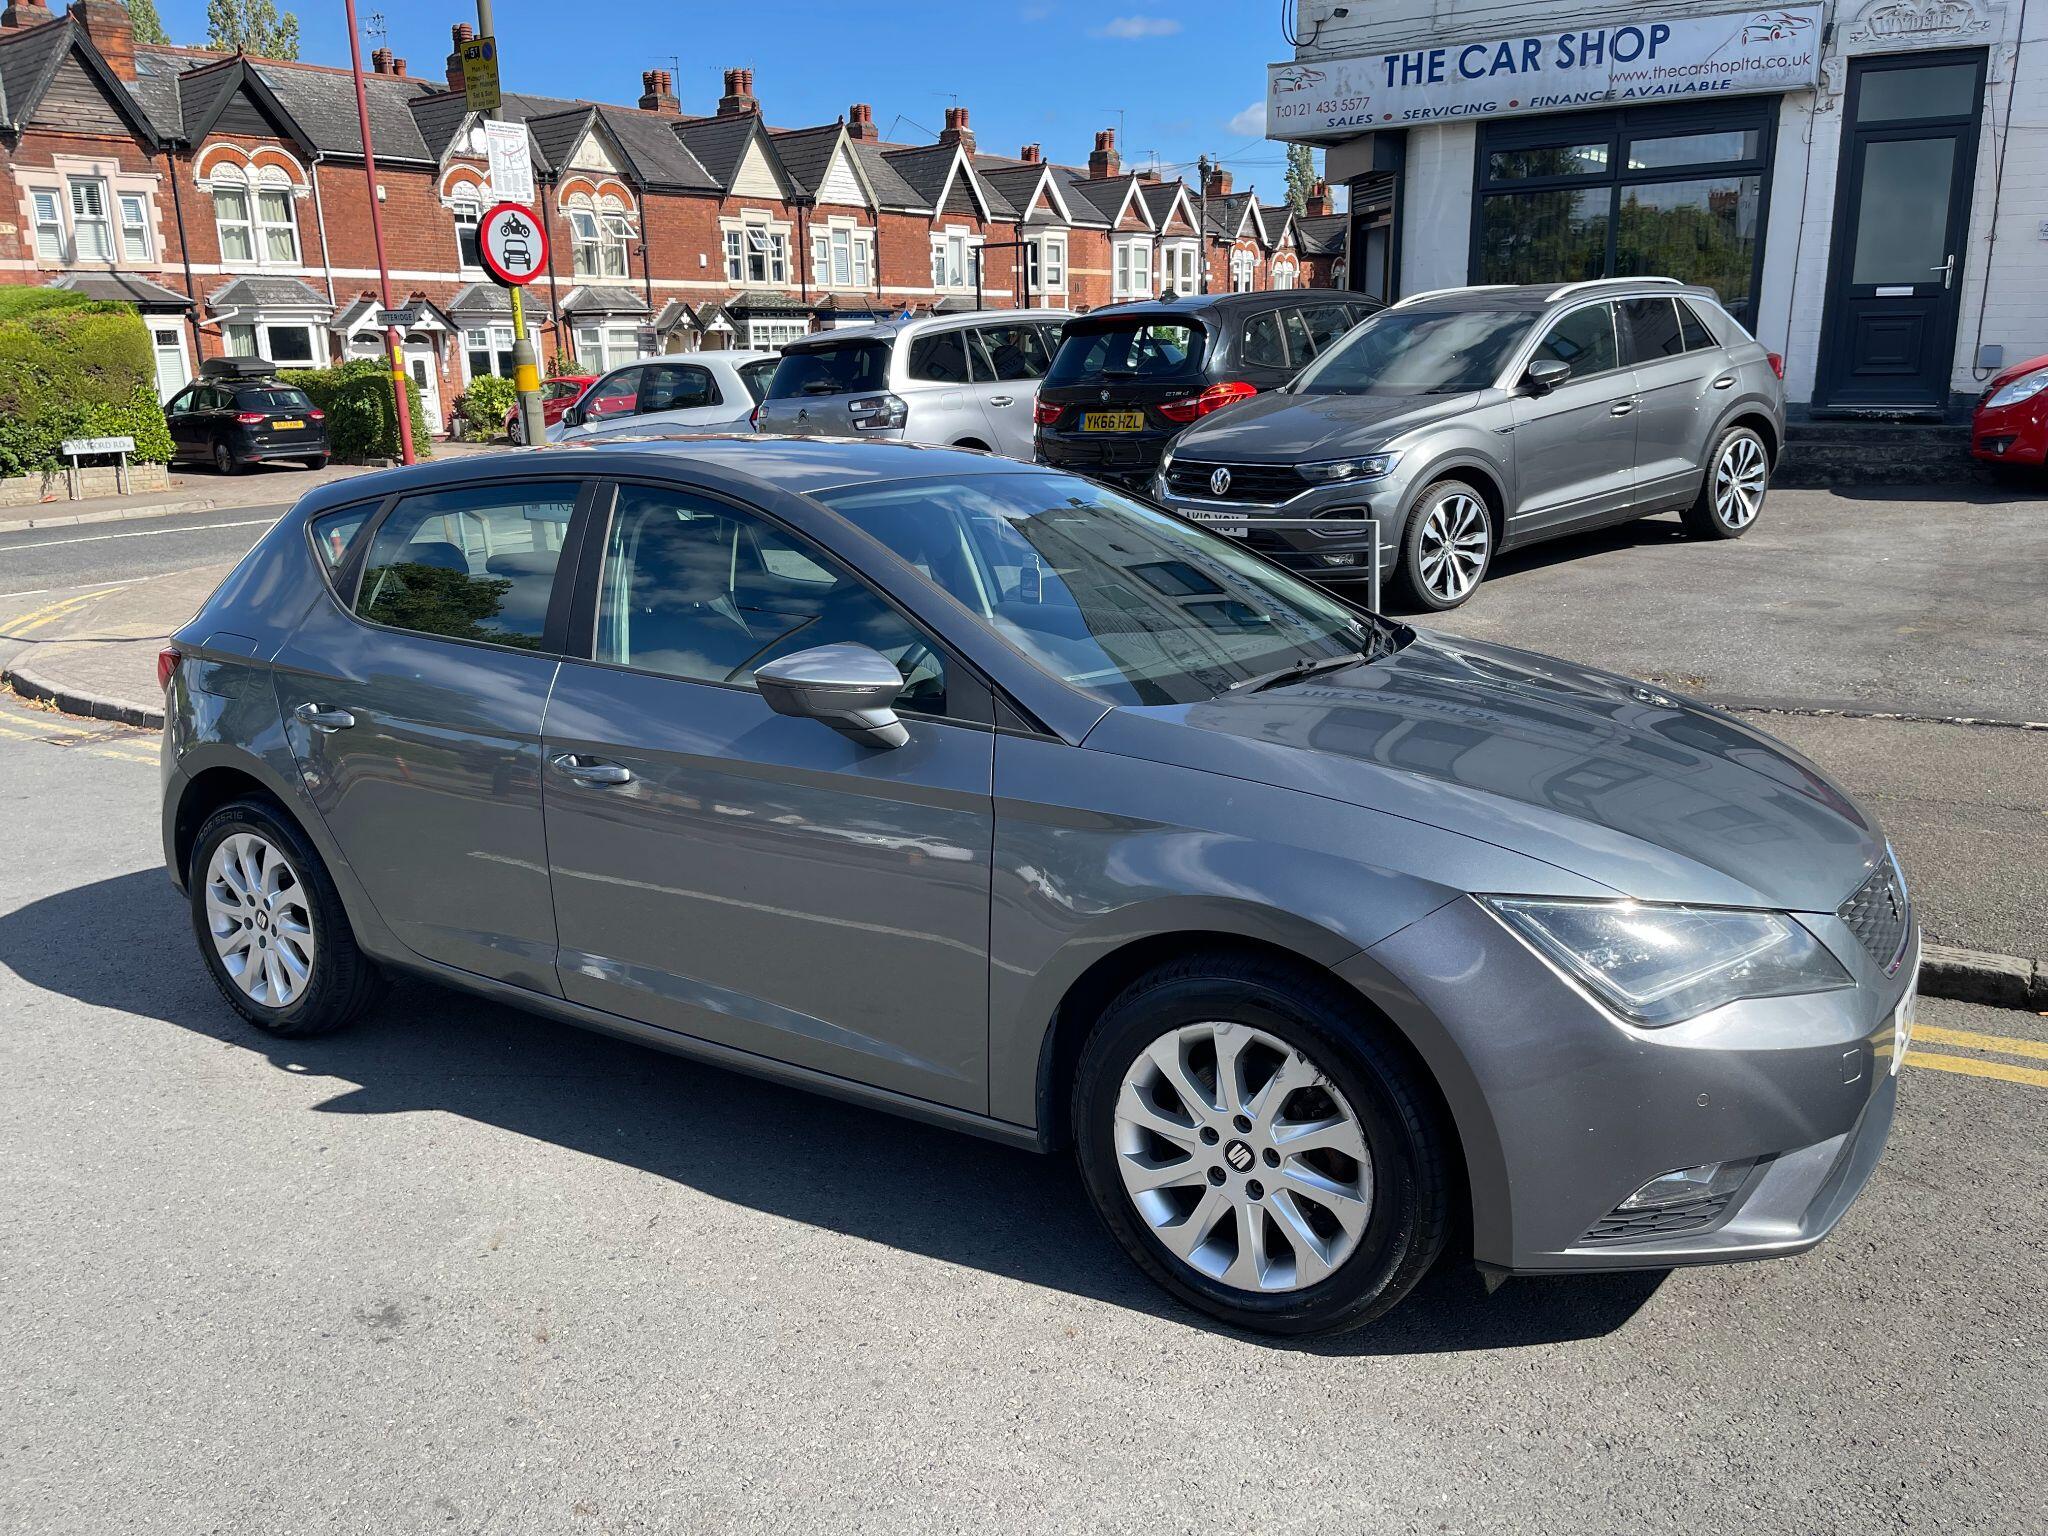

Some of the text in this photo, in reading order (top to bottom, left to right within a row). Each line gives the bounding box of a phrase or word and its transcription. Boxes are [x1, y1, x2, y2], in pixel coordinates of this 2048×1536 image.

[1384, 24, 1671, 87] THE CAR SHOP
[1608, 52, 1812, 83] www.thecarshopltd.co.uk
[1276, 97, 1370, 118] T:0121 433 5577
[1327, 79, 1732, 128] SALES SERVICING FINANCE AVAILABLE
[1086, 415, 1141, 430] YK66 HZL
